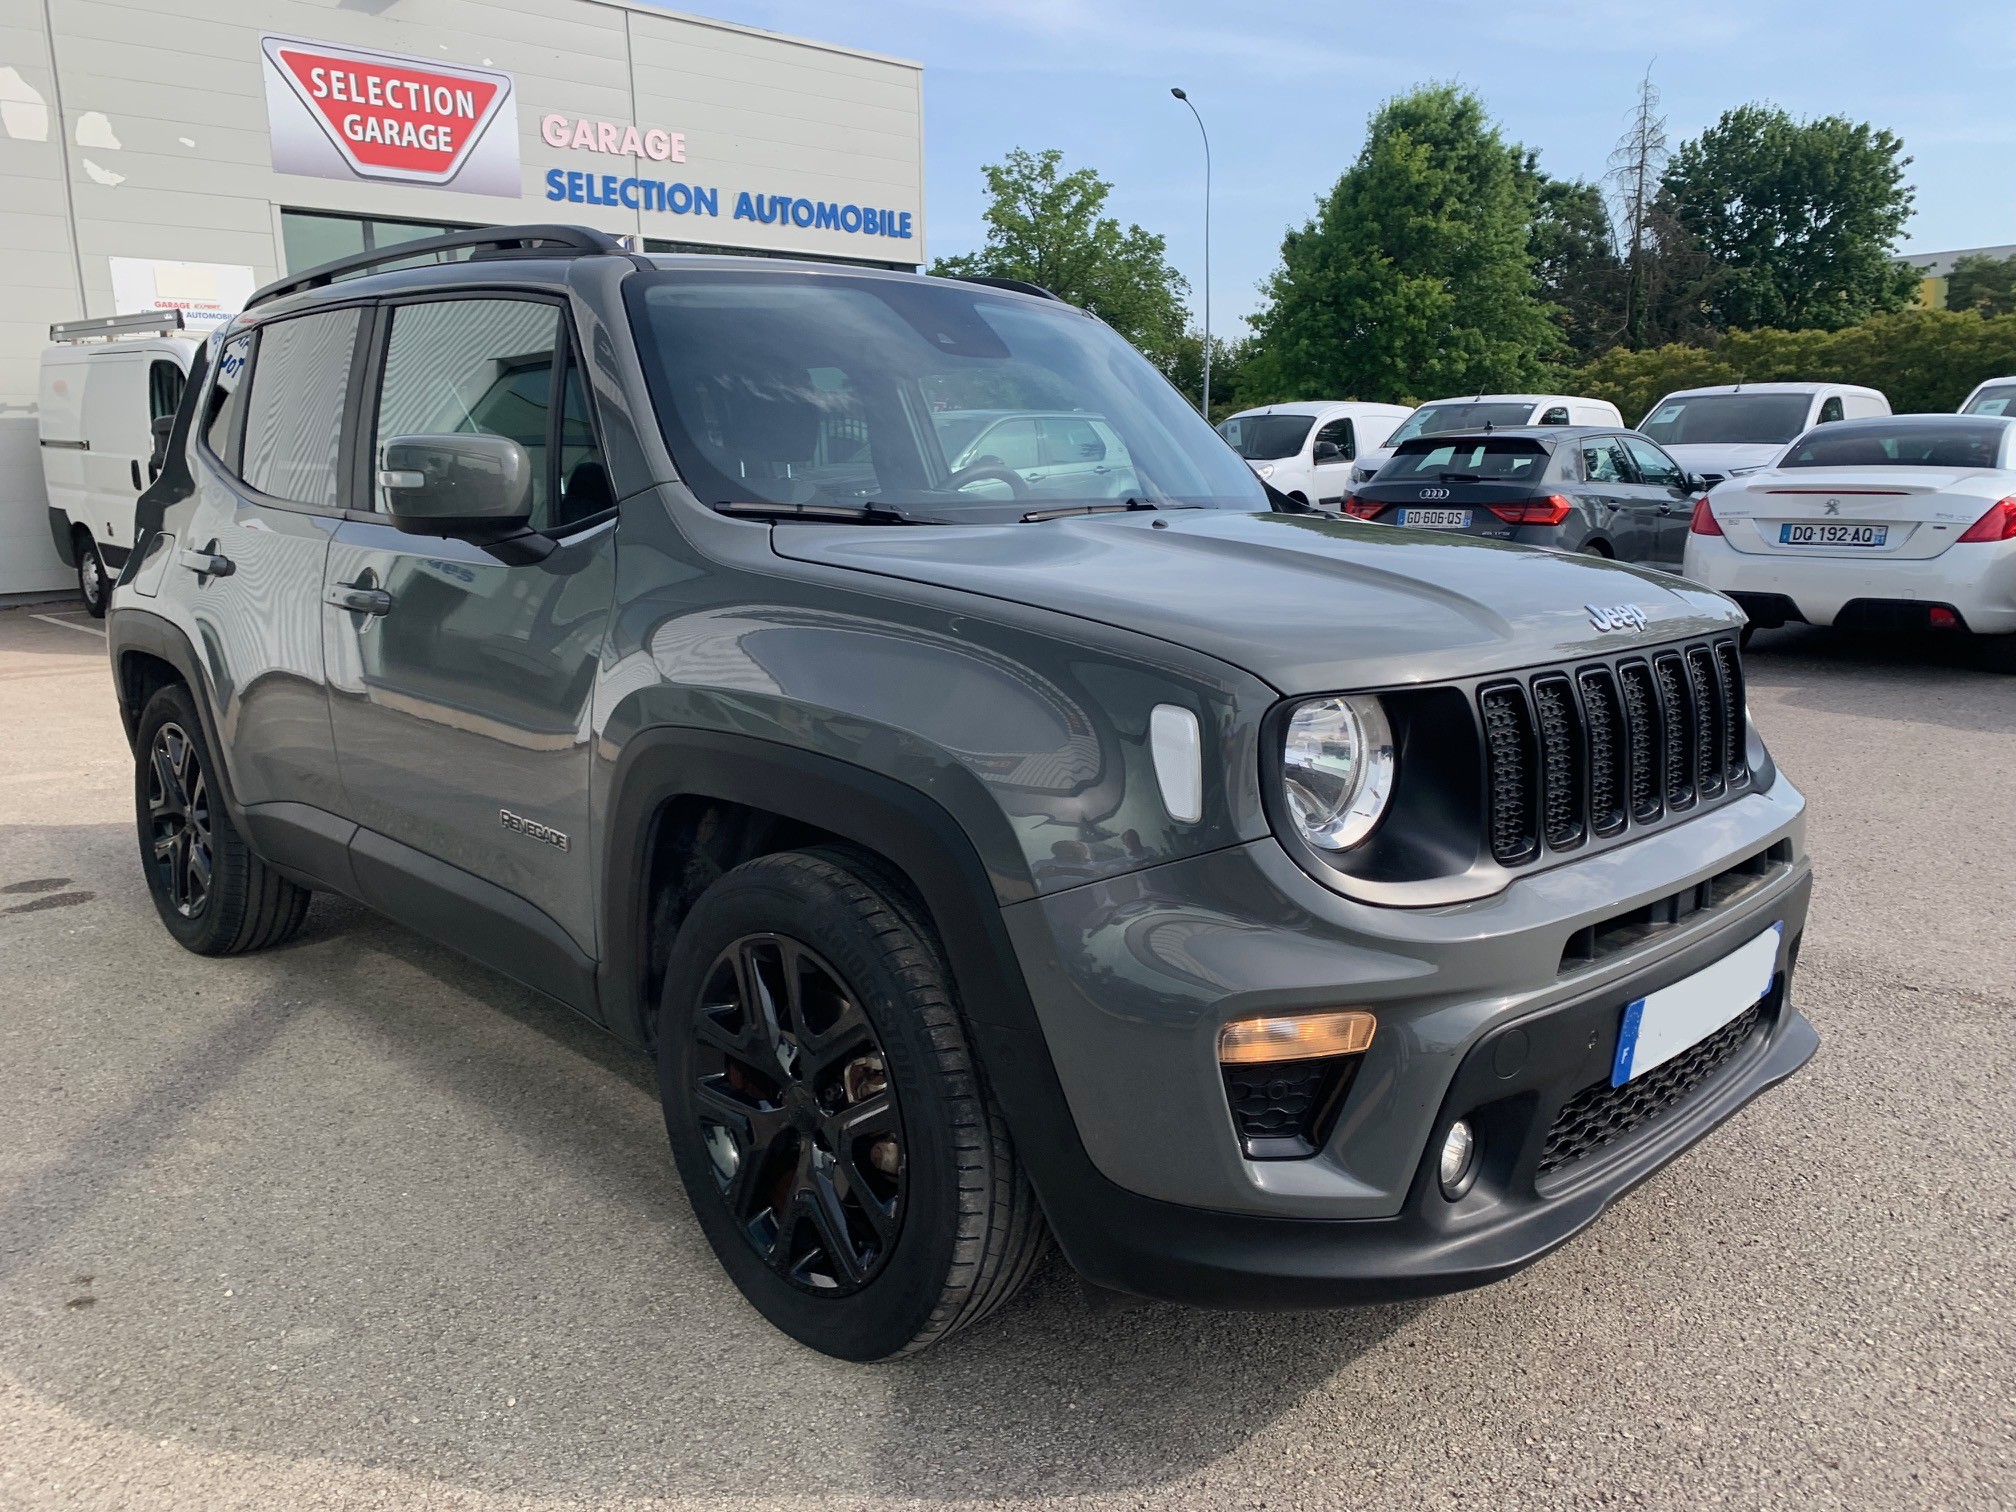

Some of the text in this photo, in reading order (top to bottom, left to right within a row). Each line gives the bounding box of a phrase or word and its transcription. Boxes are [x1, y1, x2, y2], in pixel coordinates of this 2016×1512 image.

[310, 67, 475, 119] SELECTION
[343, 114, 454, 153] GARAGE
[541, 113, 686, 163] GARAGE
[546, 168, 913, 239] SELECTION AUTOMOBILE
[154, 301, 190, 310] GARAGE
[1792, 526, 1873, 543] DQ-192-AQ
[1584, 604, 1647, 633] Jeep
[500, 808, 570, 853] RENEGADE
